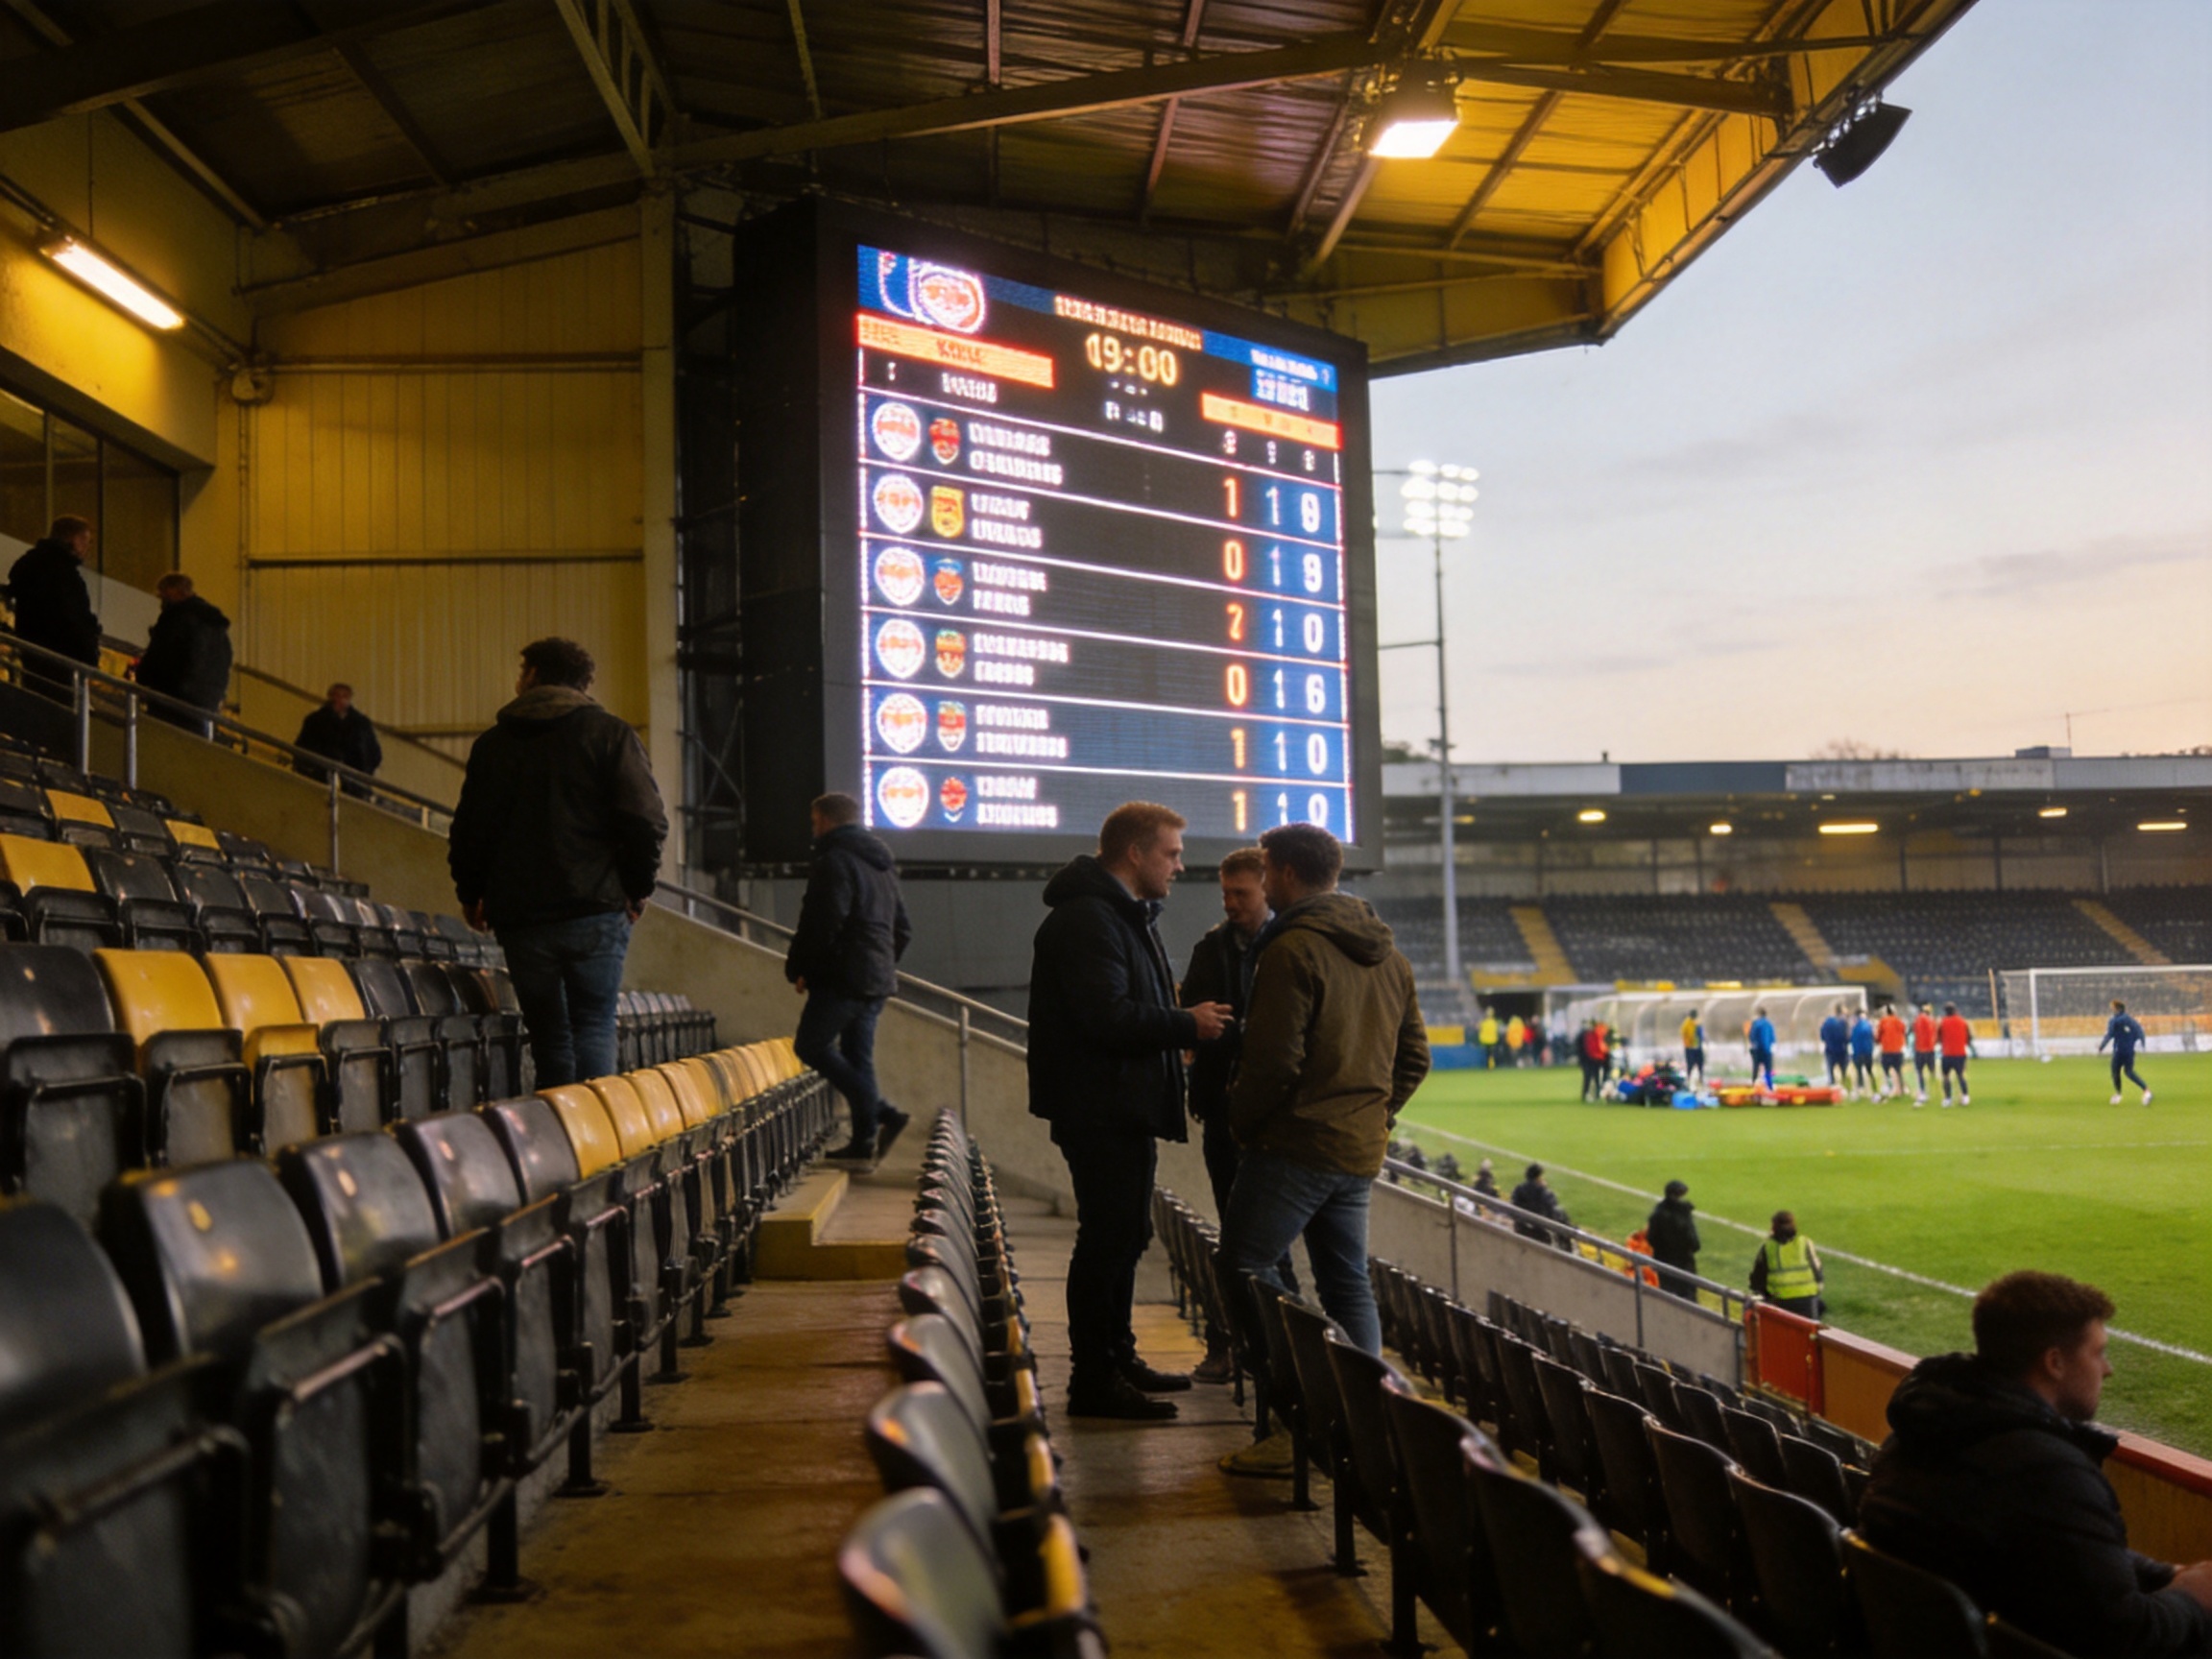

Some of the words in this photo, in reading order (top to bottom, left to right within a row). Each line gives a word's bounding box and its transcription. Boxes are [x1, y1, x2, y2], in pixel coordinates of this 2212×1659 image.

[1086, 332, 1179, 386] 19:00
[1224, 477, 1238, 518] 1
[1265, 486, 1281, 526] 1
[1224, 540, 1244, 582] 0
[1269, 545, 1282, 587] 1
[1272, 608, 1284, 648] 1
[1304, 613, 1324, 654] 0
[1226, 663, 1247, 706] 0
[1273, 668, 1285, 709] 1
[1306, 673, 1326, 714] 6
[1231, 728, 1246, 768] 1
[1274, 731, 1286, 772] 1
[1307, 733, 1328, 776] 0
[1232, 791, 1246, 831] 1
